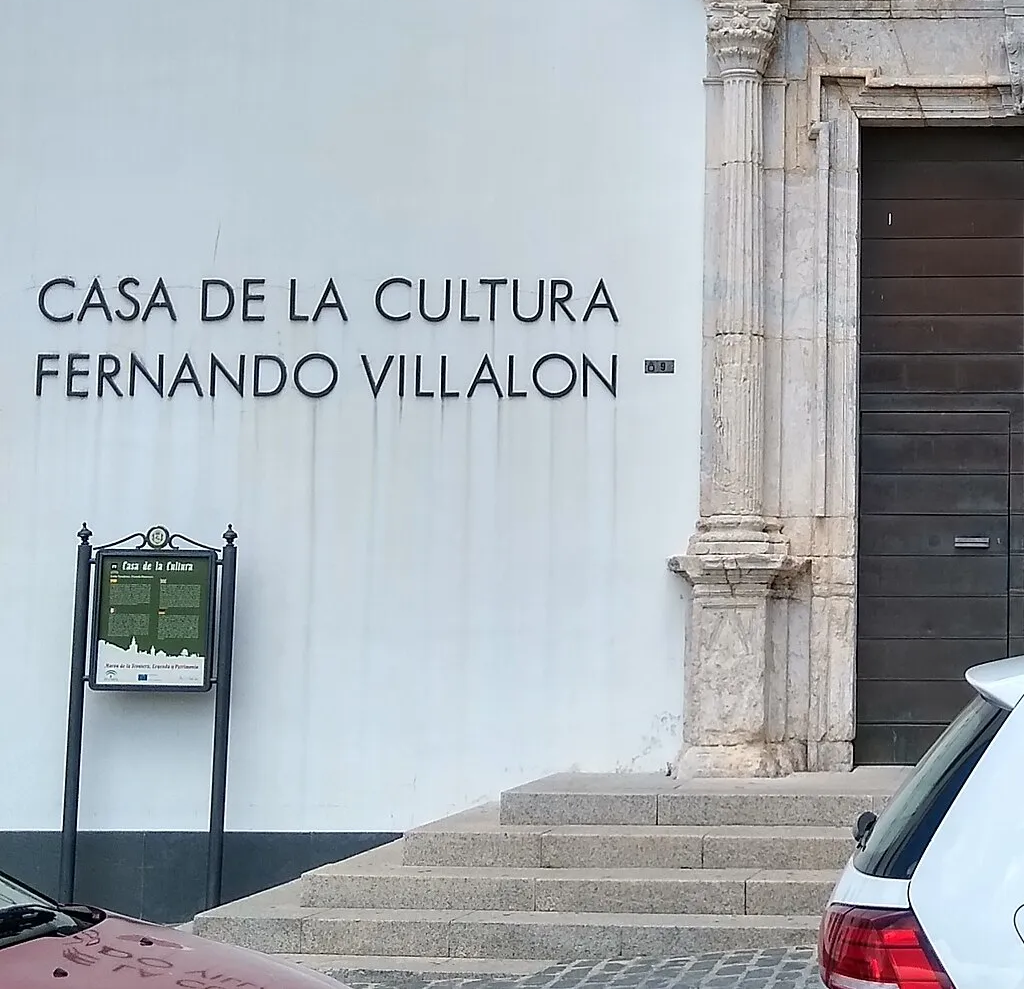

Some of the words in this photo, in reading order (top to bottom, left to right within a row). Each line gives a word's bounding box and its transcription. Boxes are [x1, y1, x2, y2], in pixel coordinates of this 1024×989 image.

[38, 276, 178, 323] CASA
[200, 277, 266, 322] DE
[289, 276, 349, 322] LA
[374, 276, 619, 323] CULTURA
[35, 352, 339, 399] FERNANDO
[360, 352, 618, 399] VILLALON
[122, 560, 140, 571] Casa
[142, 560, 152, 571] de
[155, 560, 163, 571] la
[166, 560, 194, 571] Cultura
